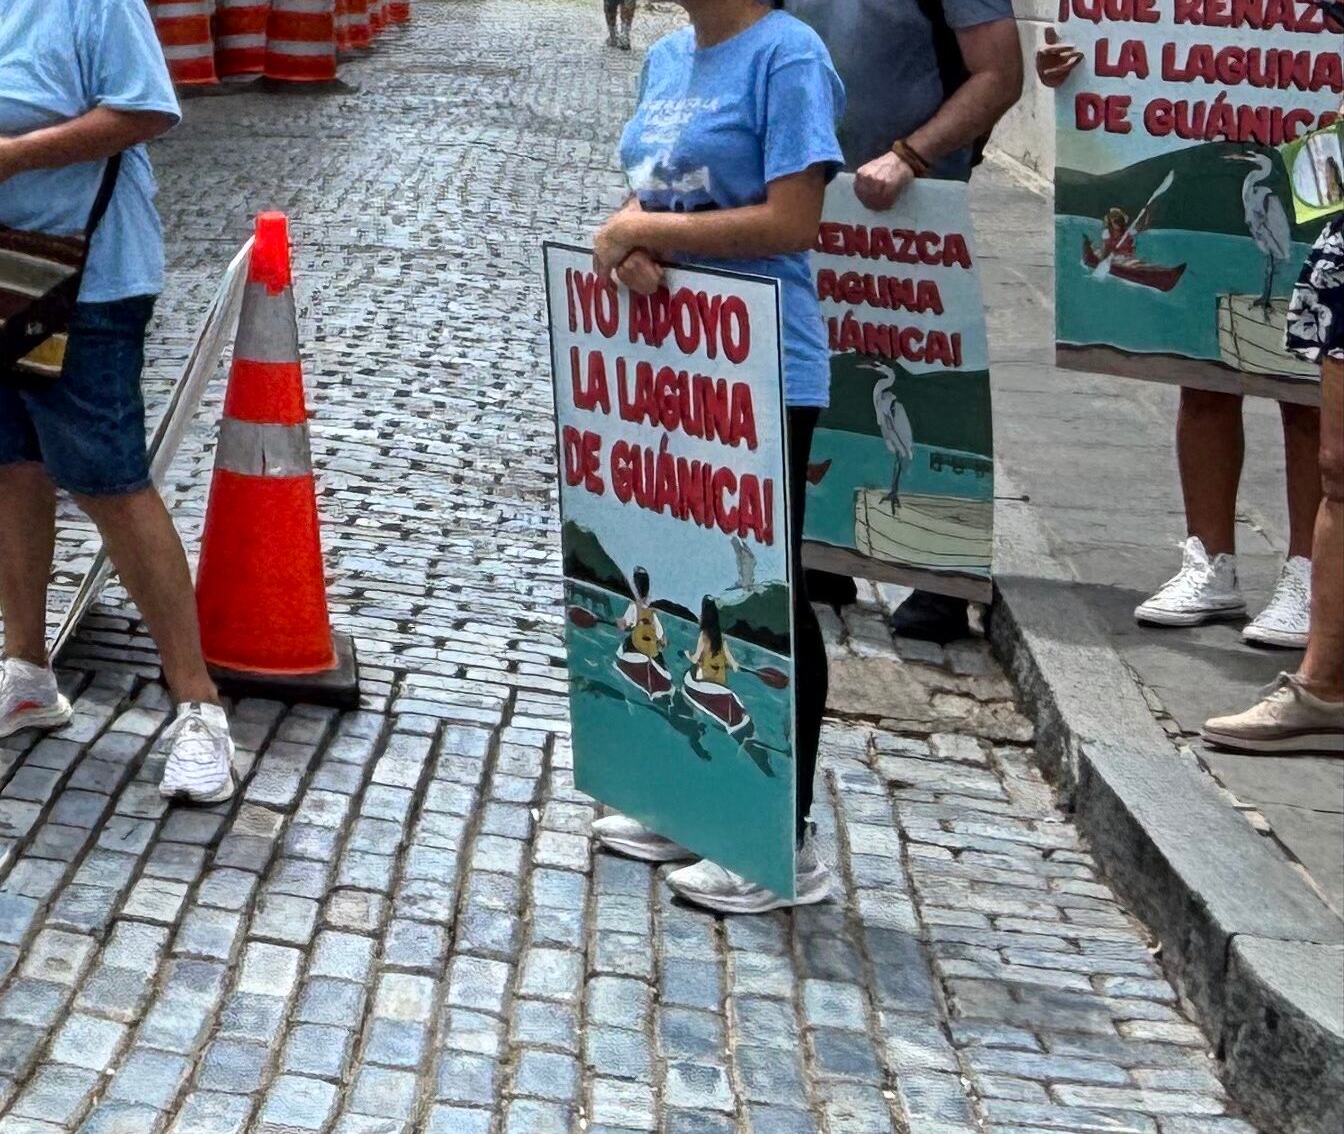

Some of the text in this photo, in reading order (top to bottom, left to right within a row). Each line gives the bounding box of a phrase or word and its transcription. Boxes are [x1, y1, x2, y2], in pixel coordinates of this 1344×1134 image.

[1094, 38, 1344, 94] LA LAGUNA
[1074, 92, 1132, 135] DE
[814, 222, 973, 269] ENAZCA
[817, 268, 945, 315] AGUNA
[628, 285, 750, 364] APOYO
[570, 346, 758, 451] LA LAGUNA
[563, 425, 774, 546] DE GUÁNICA!
